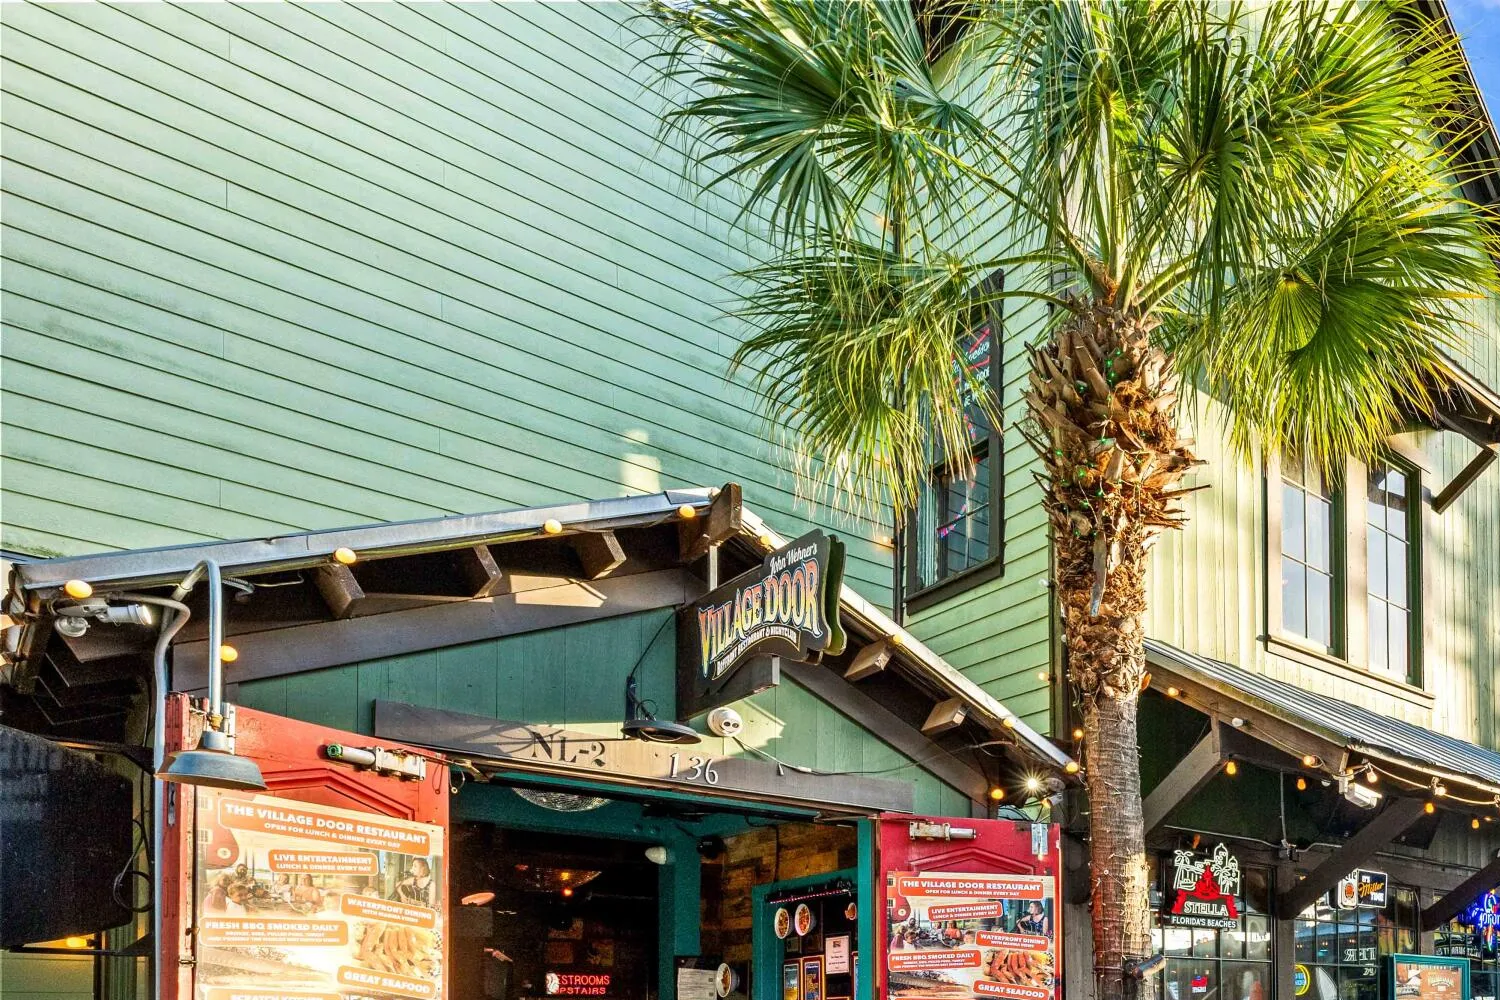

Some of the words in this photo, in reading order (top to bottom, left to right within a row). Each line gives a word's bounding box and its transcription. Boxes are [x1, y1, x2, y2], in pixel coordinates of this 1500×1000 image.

[769, 558, 788, 578] John
[786, 542, 818, 565] Wehner's
[698, 587, 764, 679] VILLAGE
[763, 558, 823, 638] DOOR
[770, 626, 797, 644] NIGHTCLUB
[532, 730, 607, 767] NL-2
[670, 753, 719, 785] 136
[225, 803, 254, 817] THE
[257, 809, 314, 826] VILLAGE
[316, 818, 354, 833] DOOR
[356, 824, 427, 845] RESTAURANT
[921, 881, 957, 889] VILLAGE
[958, 882, 985, 890] DOOR
[986, 883, 1041, 891] RESTAURANT
[1359, 882, 1384, 898] Miller
[1183, 903, 1229, 915] STELLA
[1171, 916, 1206, 927] FLORIDA'S
[1207, 918, 1237, 929] BEACHES
[557, 975, 610, 985] ESTROOMS
[978, 984, 1005, 993] GREAT
[1006, 988, 1045, 998] SEAFOOD
